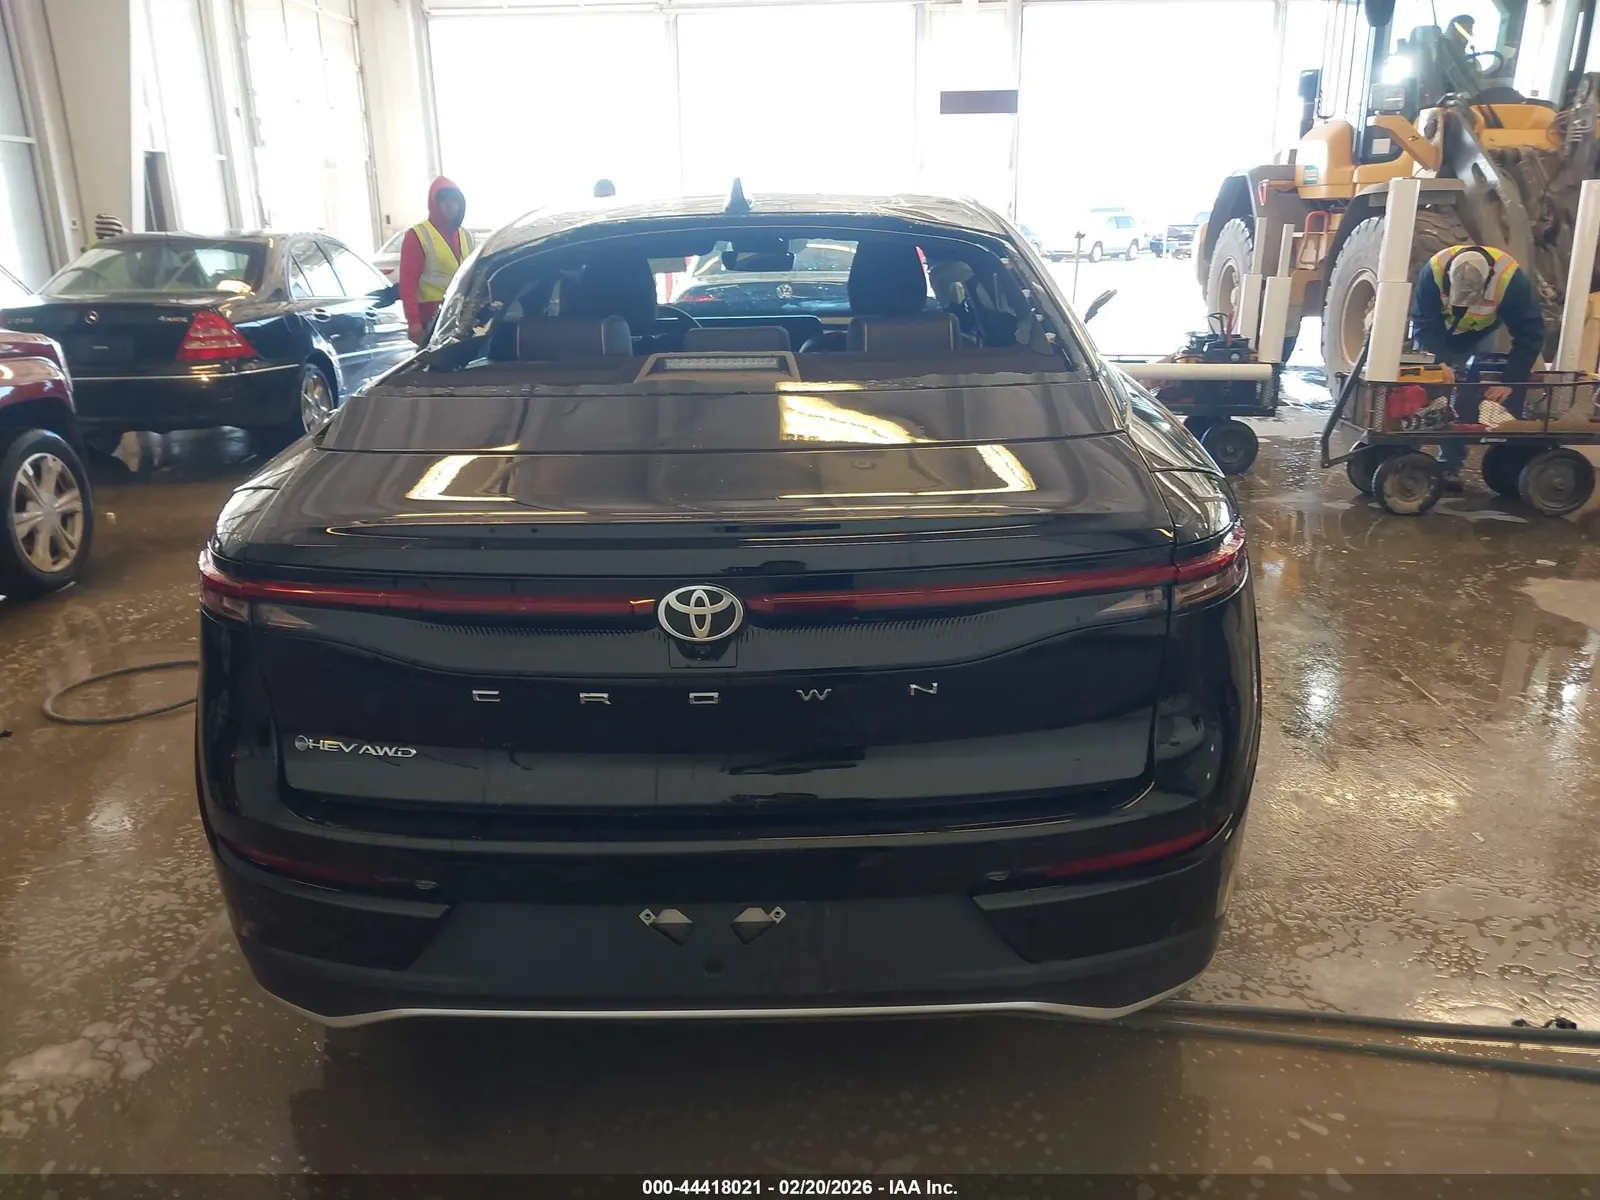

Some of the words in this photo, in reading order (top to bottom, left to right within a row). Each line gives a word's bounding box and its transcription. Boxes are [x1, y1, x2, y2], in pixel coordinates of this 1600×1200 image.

[472, 682, 938, 705] CROWN
[308, 739, 358, 753] HEV
[359, 744, 417, 758] AWD
